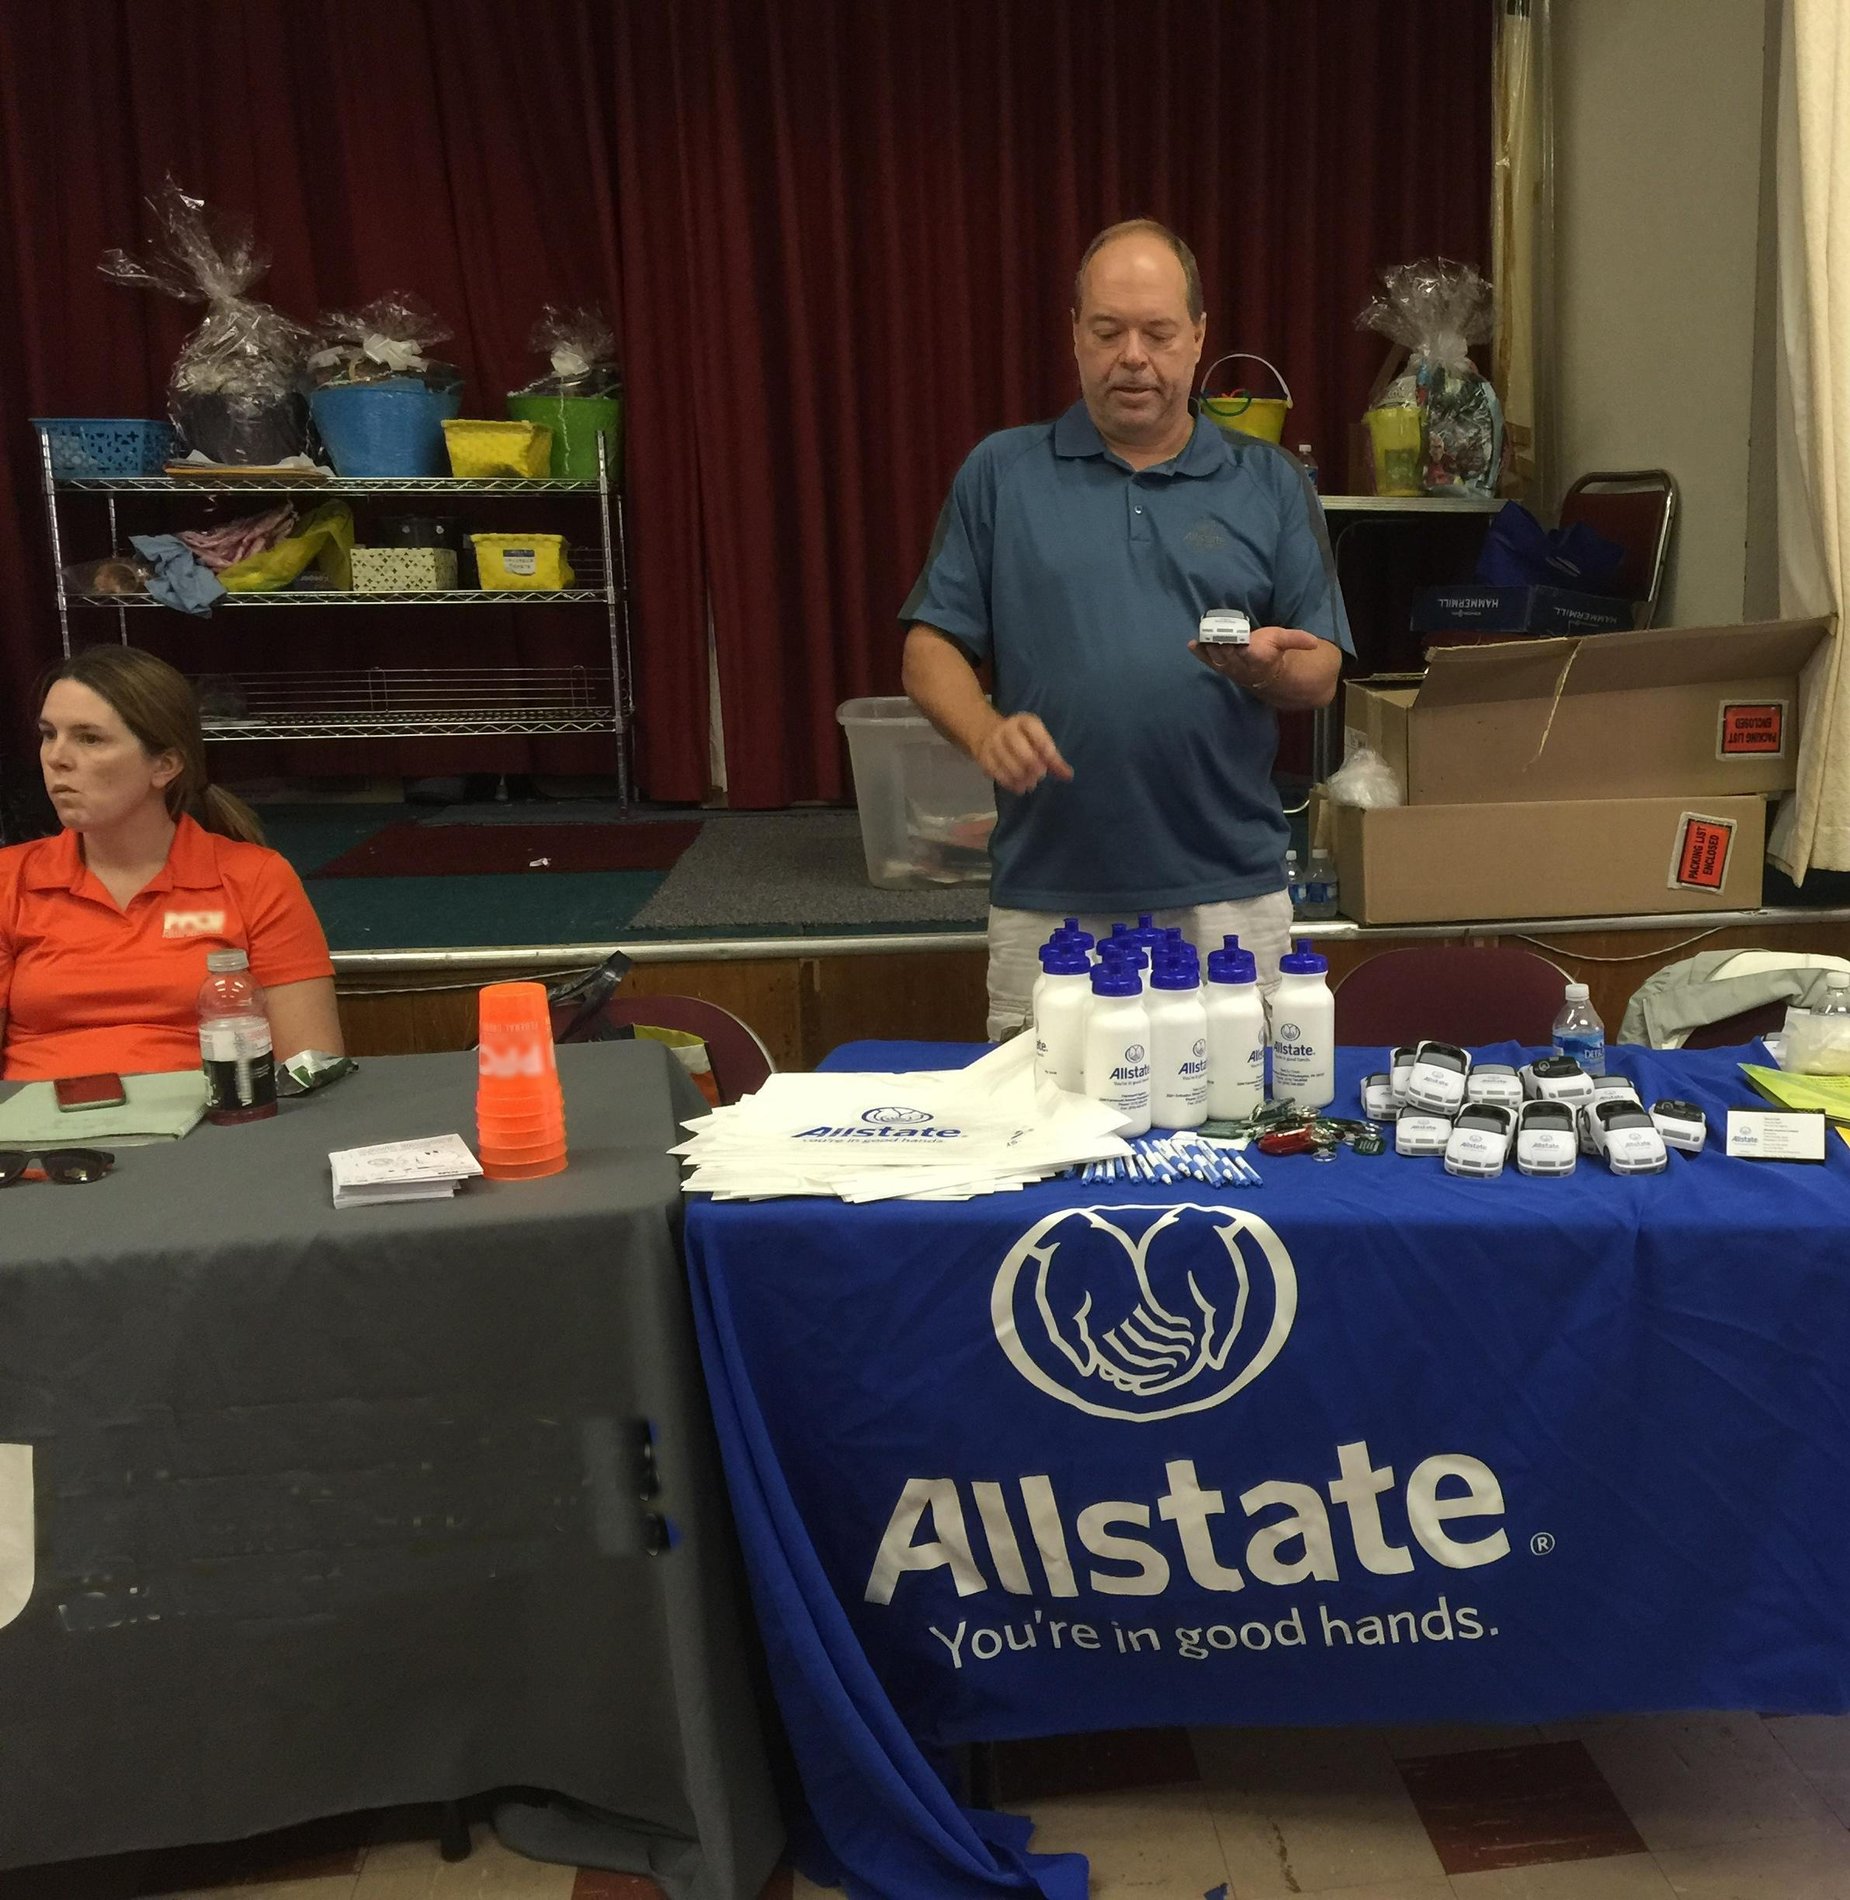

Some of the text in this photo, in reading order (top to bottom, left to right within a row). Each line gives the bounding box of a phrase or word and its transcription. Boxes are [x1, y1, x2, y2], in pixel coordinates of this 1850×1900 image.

[1439, 598, 1500, 609] HAMMERMILL
[1553, 607, 1618, 625] HAMMERMILL
[1728, 732, 1777, 744] PACKING LIST
[1688, 827, 1707, 880] PACKING LIST
[1702, 834, 1720, 876] ENCLOSED
[791, 1126, 963, 1139] Allstate
[864, 1441, 1512, 1605] Allstate
[928, 1596, 1501, 1669] You're in good hands.
